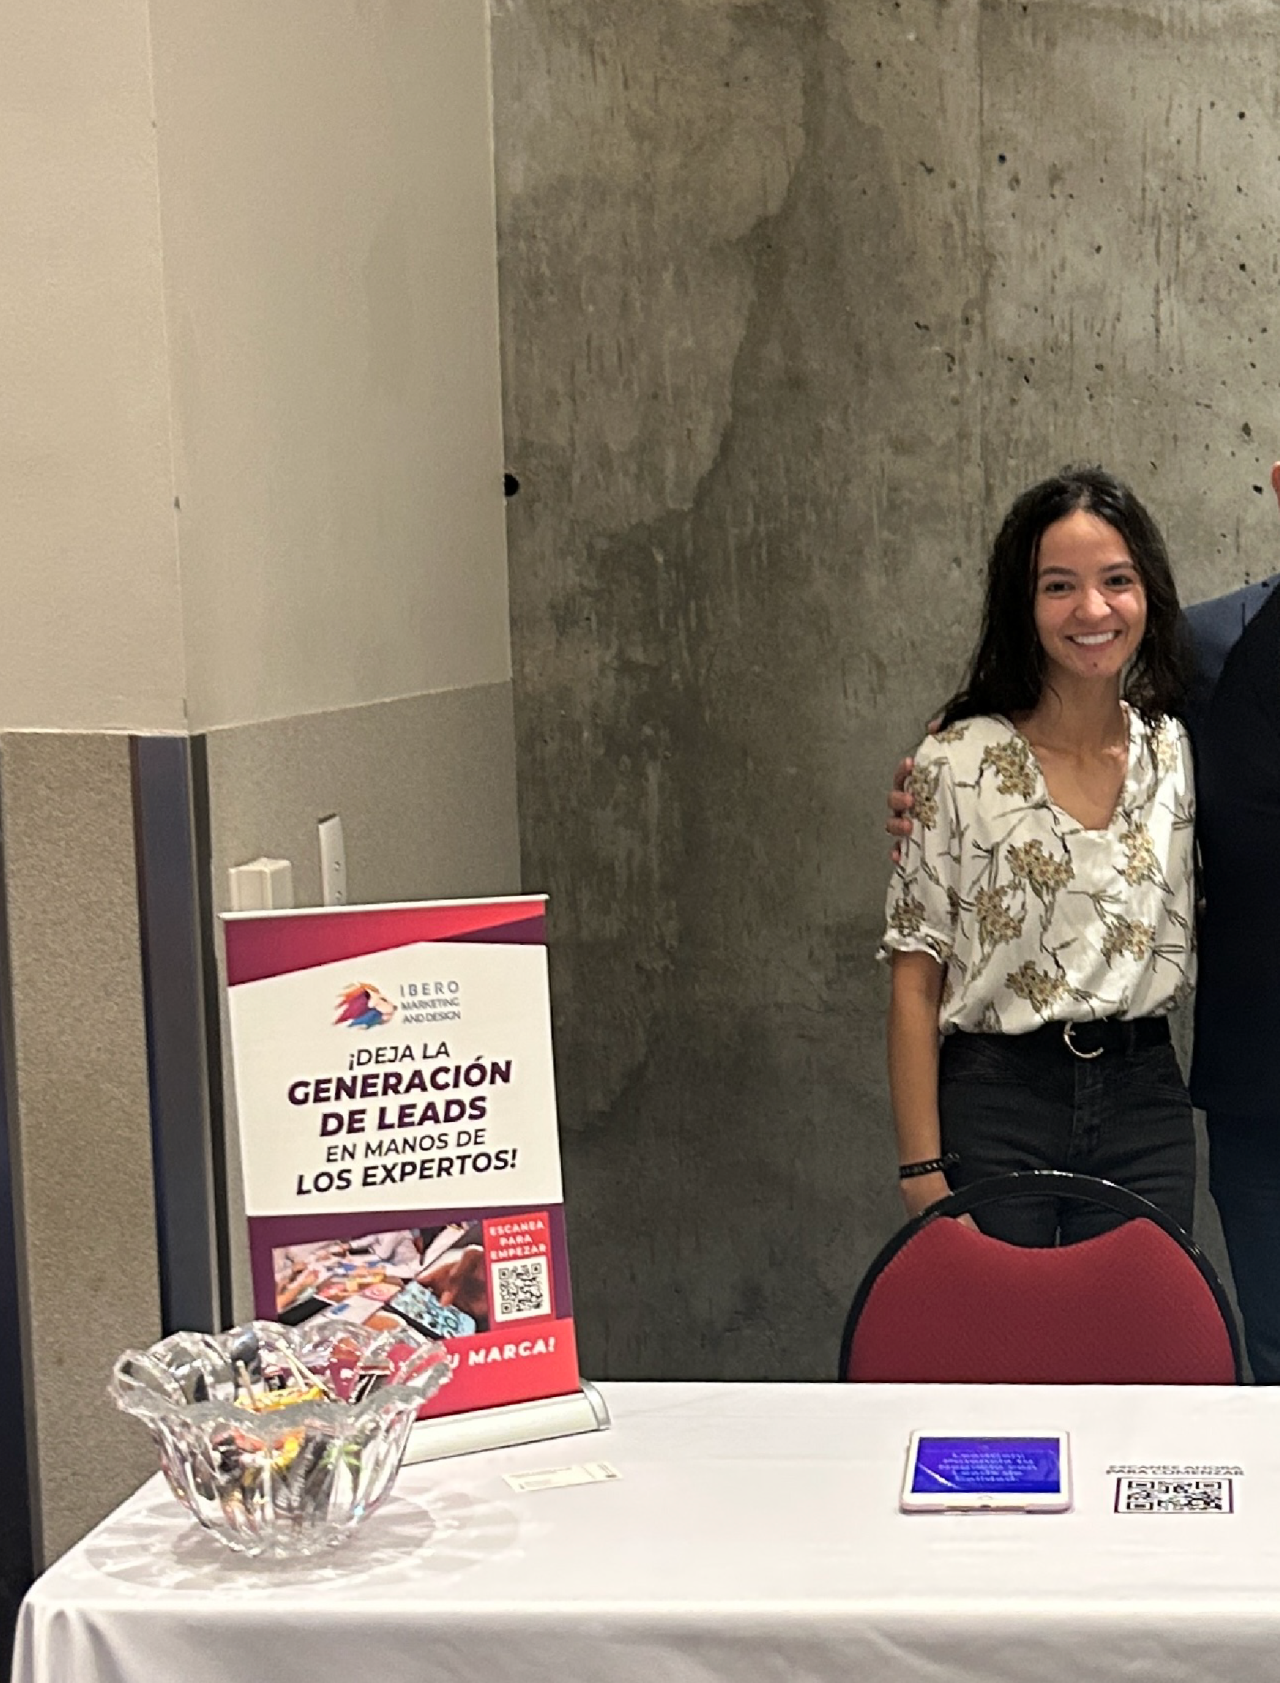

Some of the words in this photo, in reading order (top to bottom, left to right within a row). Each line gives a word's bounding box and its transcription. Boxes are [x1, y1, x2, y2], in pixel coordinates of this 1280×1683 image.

[400, 980, 459, 998] IBERO
[401, 997, 460, 1011] MARKETING
[402, 1012, 425, 1024] AND
[425, 1010, 461, 1022] DESIGN
[348, 1045, 415, 1071] ¡DEJA
[422, 1041, 450, 1060] LA
[287, 1055, 512, 1106] GENERACIÓN
[319, 1109, 367, 1137] DE
[377, 1096, 488, 1131] LEADS
[326, 1143, 357, 1163] EN
[364, 1132, 449, 1159] MANOS
[456, 1128, 487, 1148] DE
[296, 1169, 352, 1196] LOS
[361, 1148, 518, 1187] EXPERTOS!
[489, 1219, 545, 1237] ESCANEA
[490, 1243, 547, 1261] EMPEZAR
[499, 1233, 533, 1248] PARA
[468, 1336, 556, 1367] MARCA!
